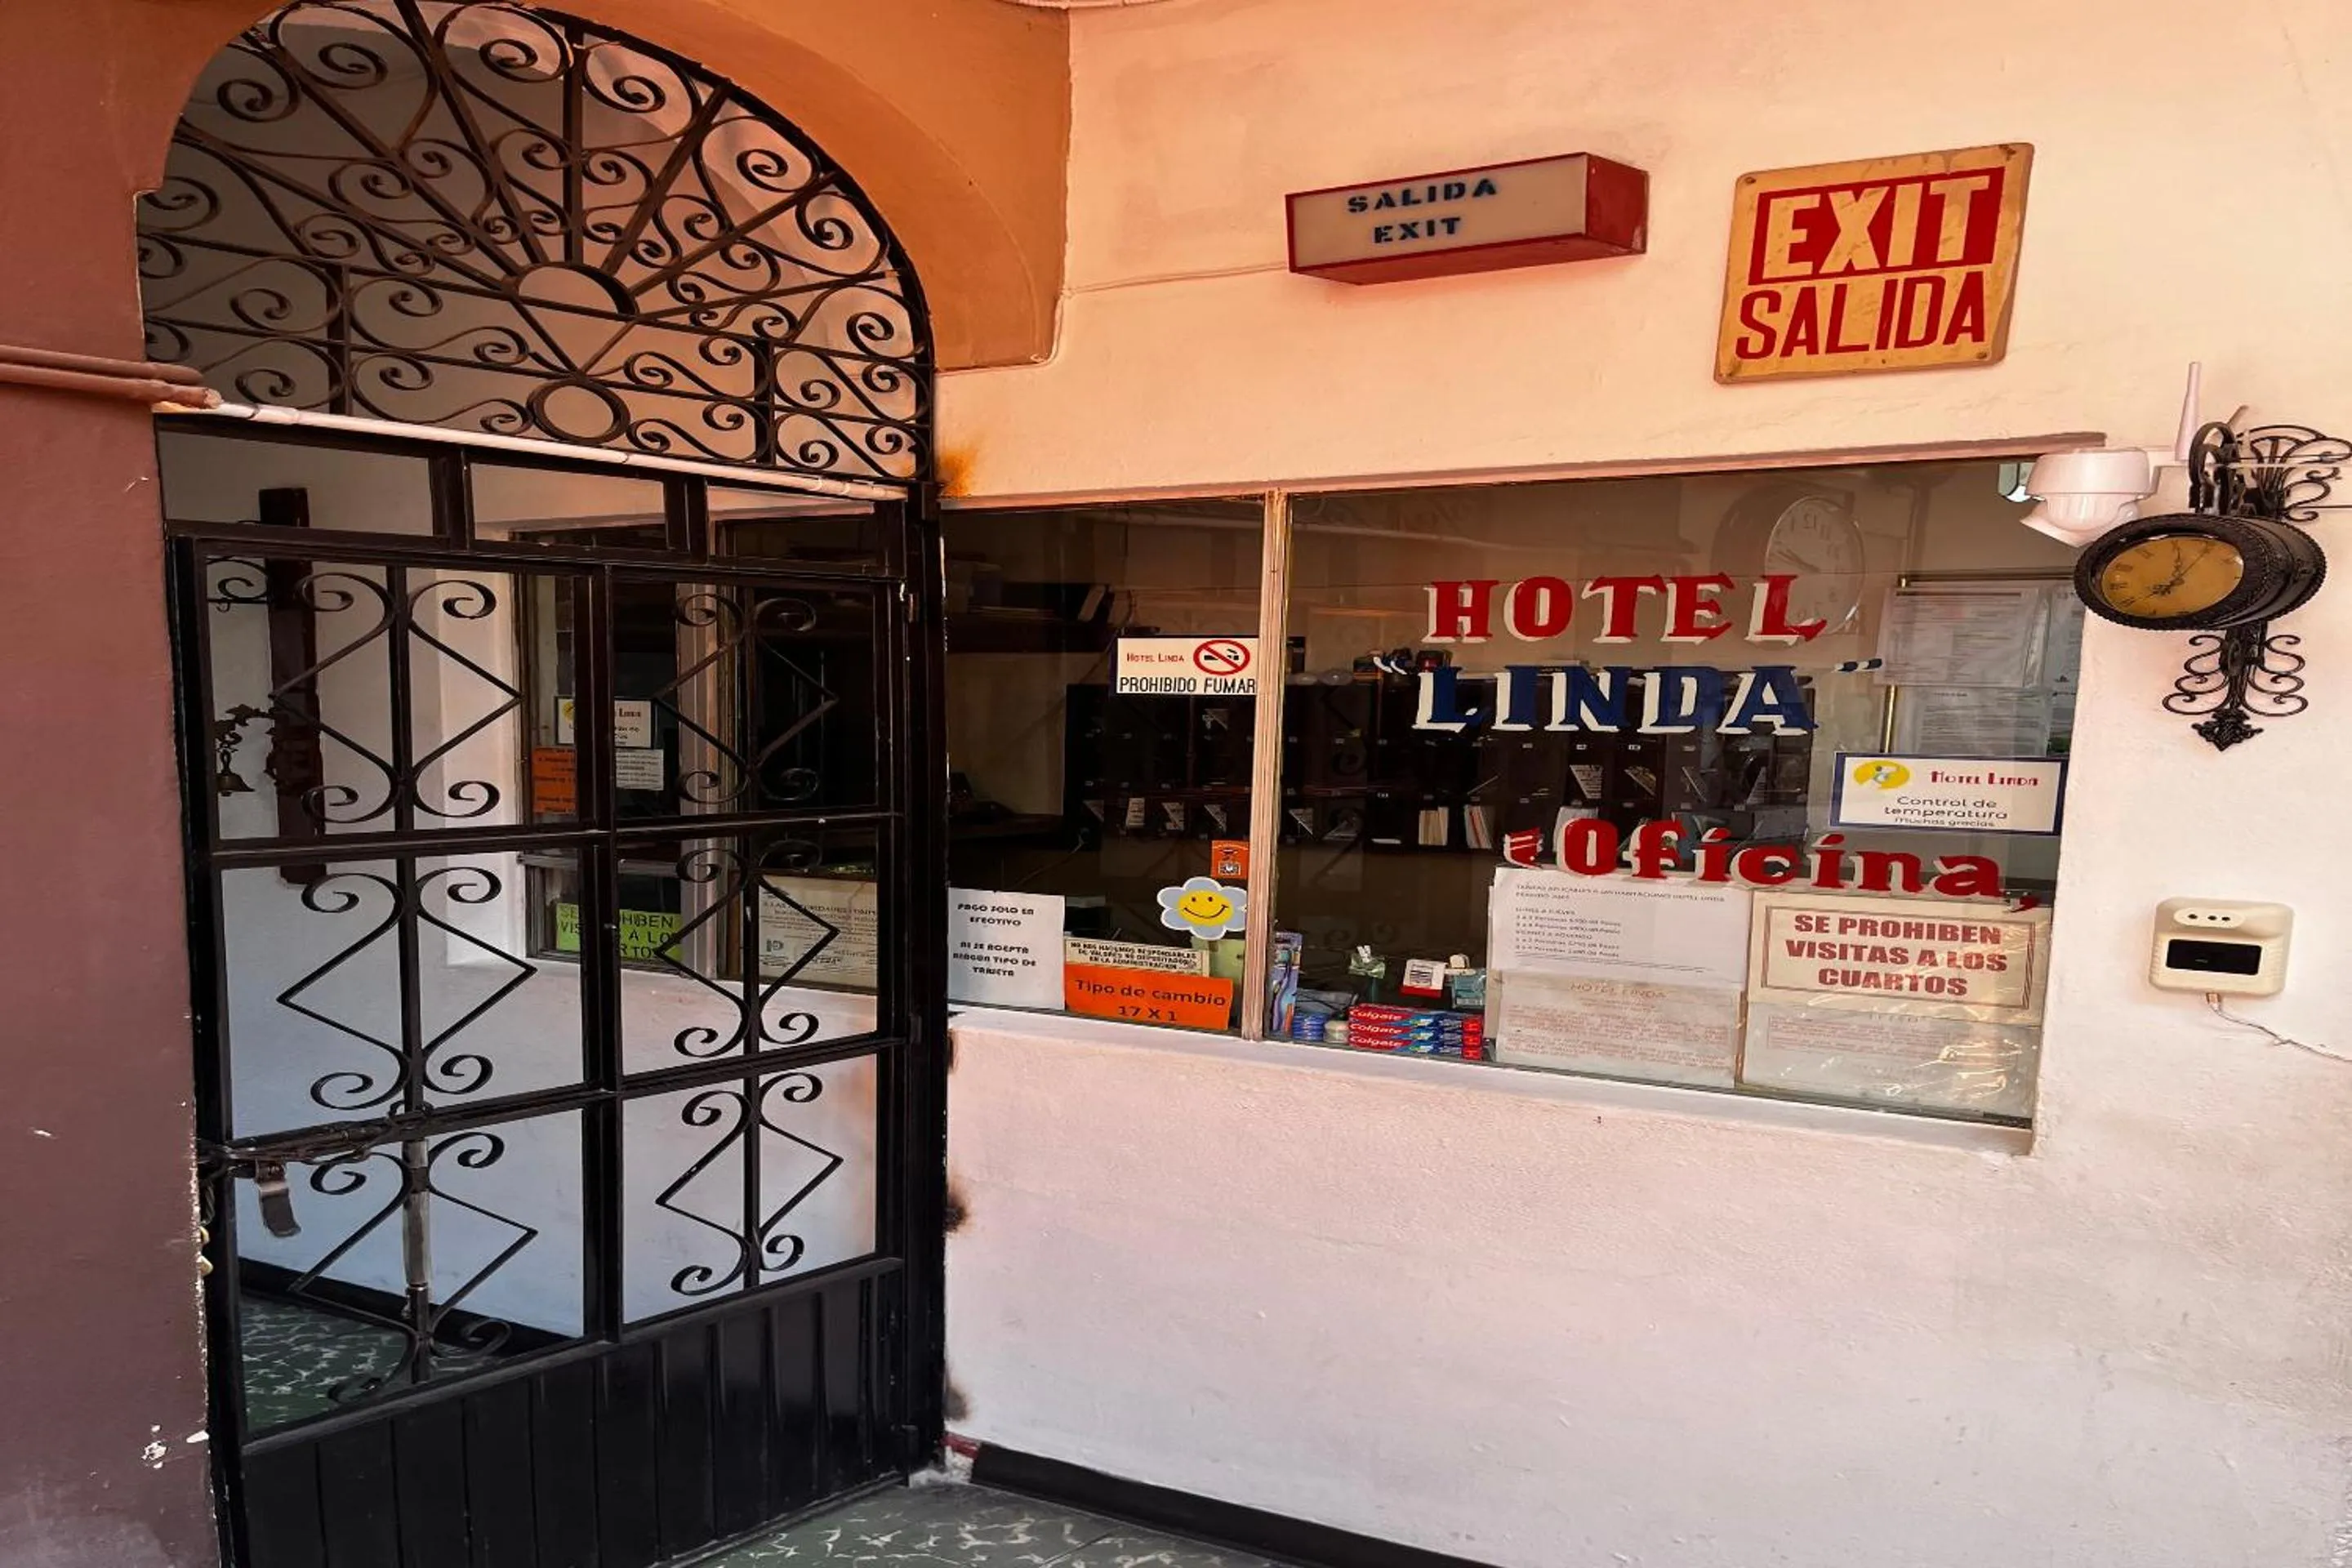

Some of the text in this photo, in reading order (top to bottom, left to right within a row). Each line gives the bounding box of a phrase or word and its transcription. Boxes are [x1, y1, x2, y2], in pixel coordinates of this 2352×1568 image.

[1348, 178, 1497, 214] SALIDA
[1374, 216, 1461, 243] EXIT
[1762, 175, 1990, 279] EXIT
[1735, 270, 1985, 359] SALIDA
[1421, 572, 1828, 645] HOTEL
[1119, 677, 1256, 693] PROHIBIDO FUMAR
[1884, 806, 2008, 821] temperatura
[1897, 795, 1998, 808] Control de
[1794, 915, 2002, 945] SE PROHIBEN
[1784, 939, 2008, 972] VISITAS A LOS
[1075, 979, 1226, 1006] Tipo de cambio
[1818, 968, 1968, 996] CUARTOS
[1119, 1006, 1177, 1022] 17 X 1
[1349, 1009, 1403, 1021] Colgate
[1348, 1036, 1404, 1048] Colgate
[1349, 1022, 1403, 1035] Colgate
